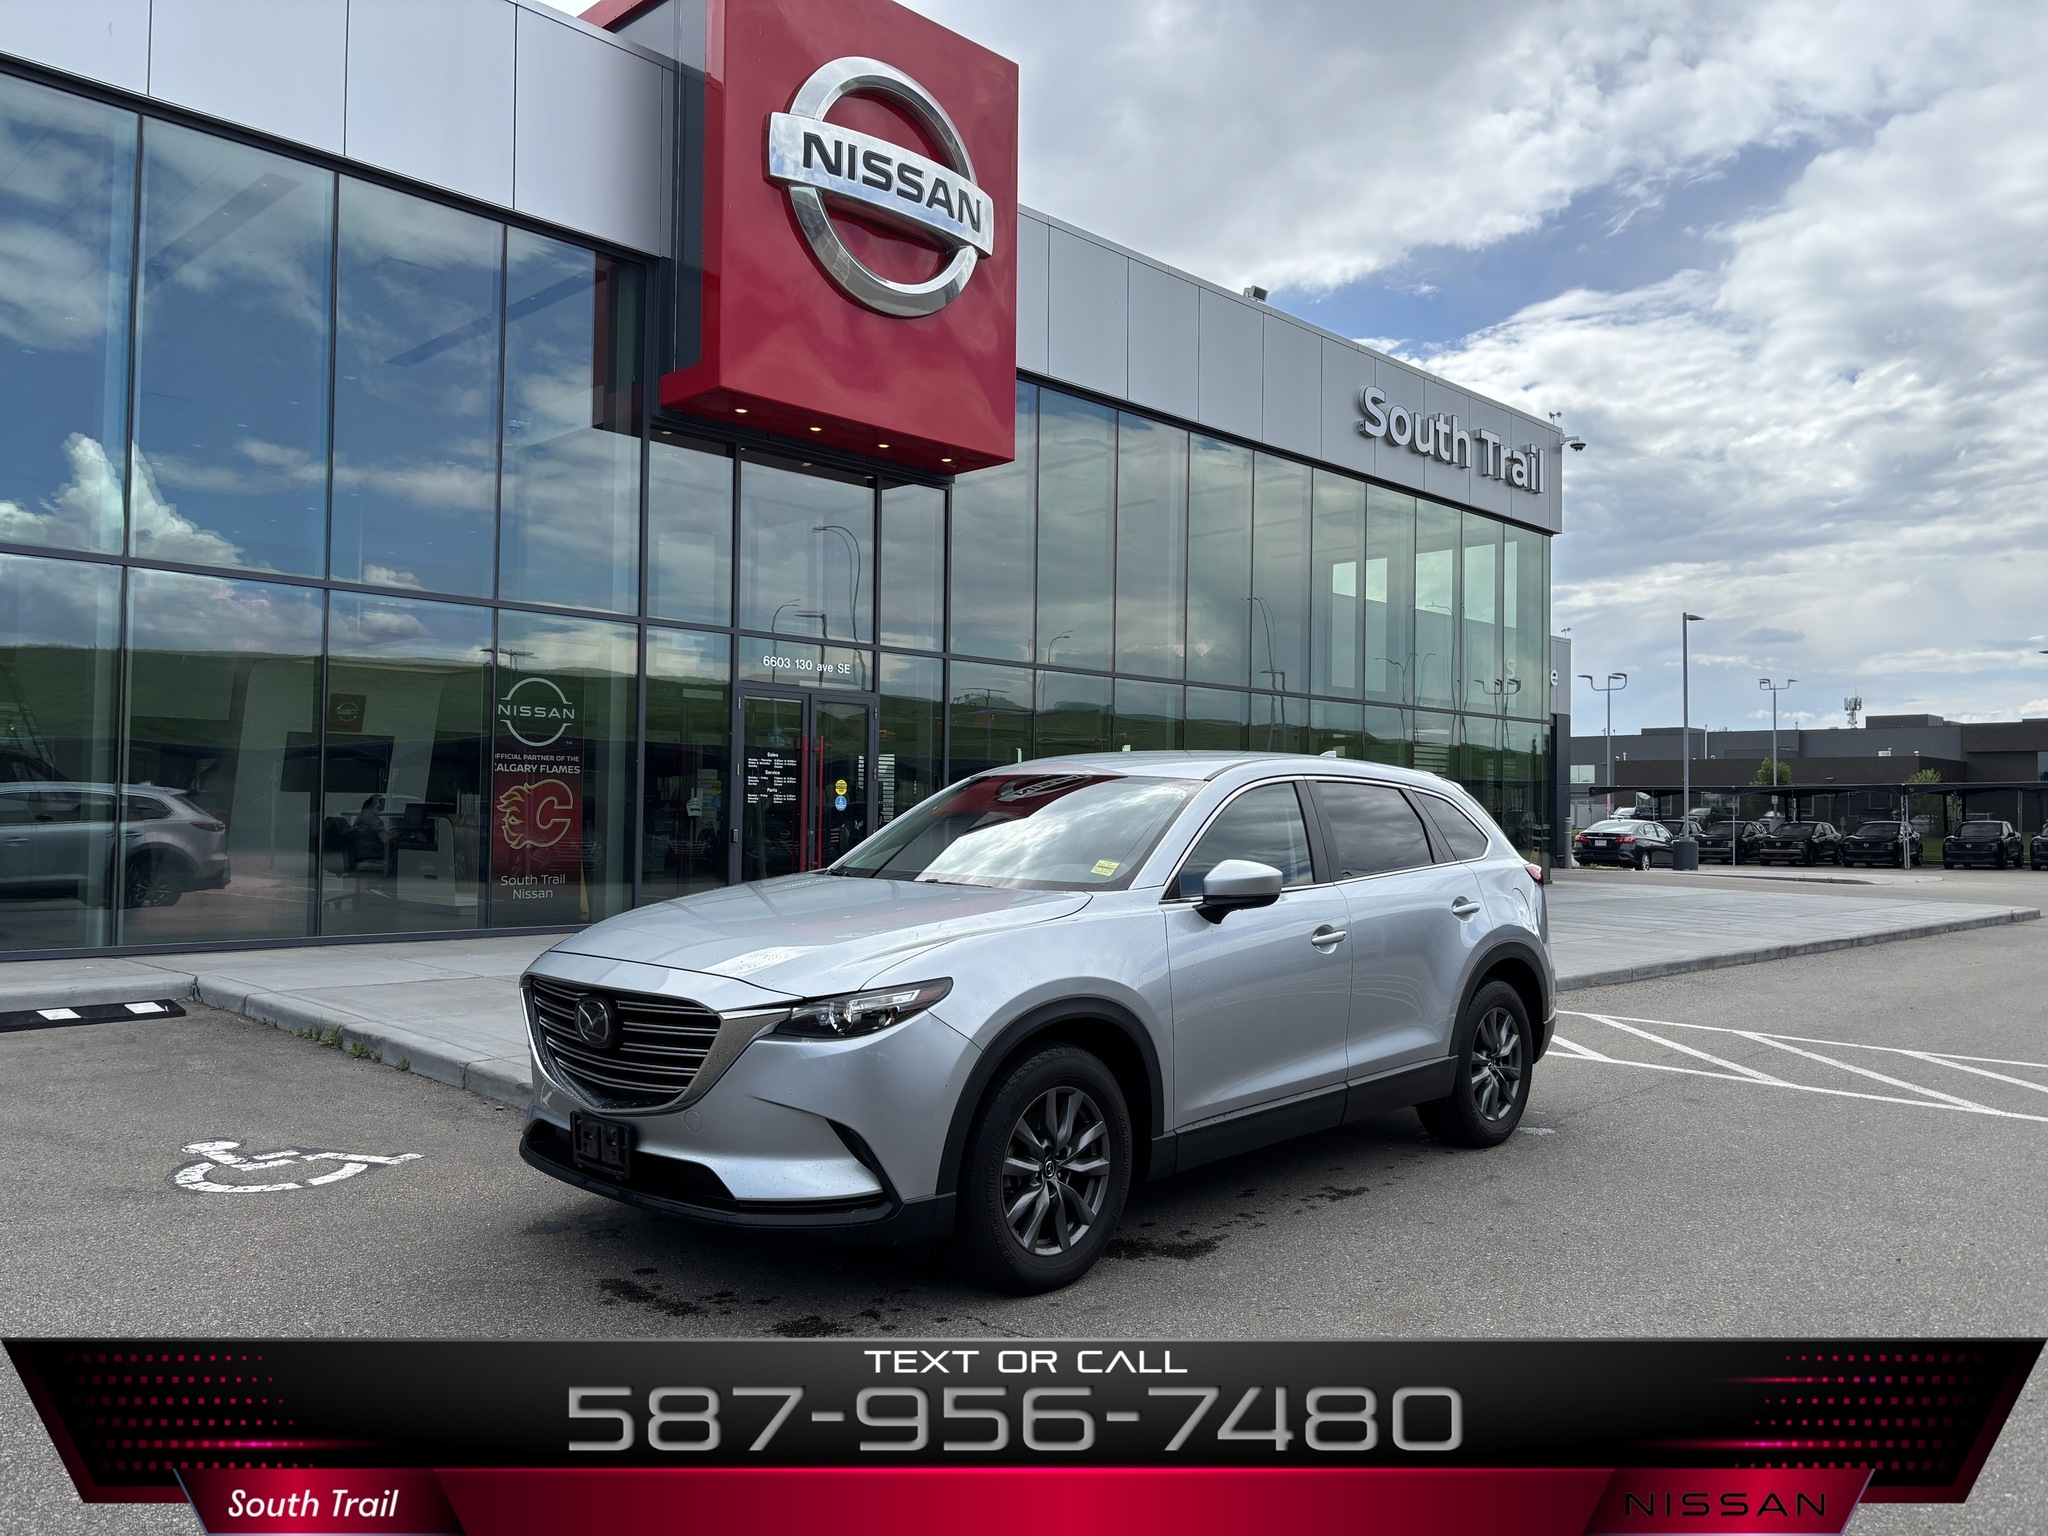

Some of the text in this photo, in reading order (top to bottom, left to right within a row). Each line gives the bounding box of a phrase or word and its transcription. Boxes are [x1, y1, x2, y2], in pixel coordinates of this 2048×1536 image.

[802, 131, 982, 233] NISSAN
[1358, 385, 1545, 494] South Trail
[762, 655, 851, 674] 6603 130 ave SE
[497, 704, 576, 720] NISSAN
[494, 752, 522, 761] FFICIAL
[523, 754, 555, 762] PARTNER
[494, 762, 581, 774] ALGARY FLAMES
[500, 873, 566, 886] South Trail
[512, 888, 554, 900] Nissan
